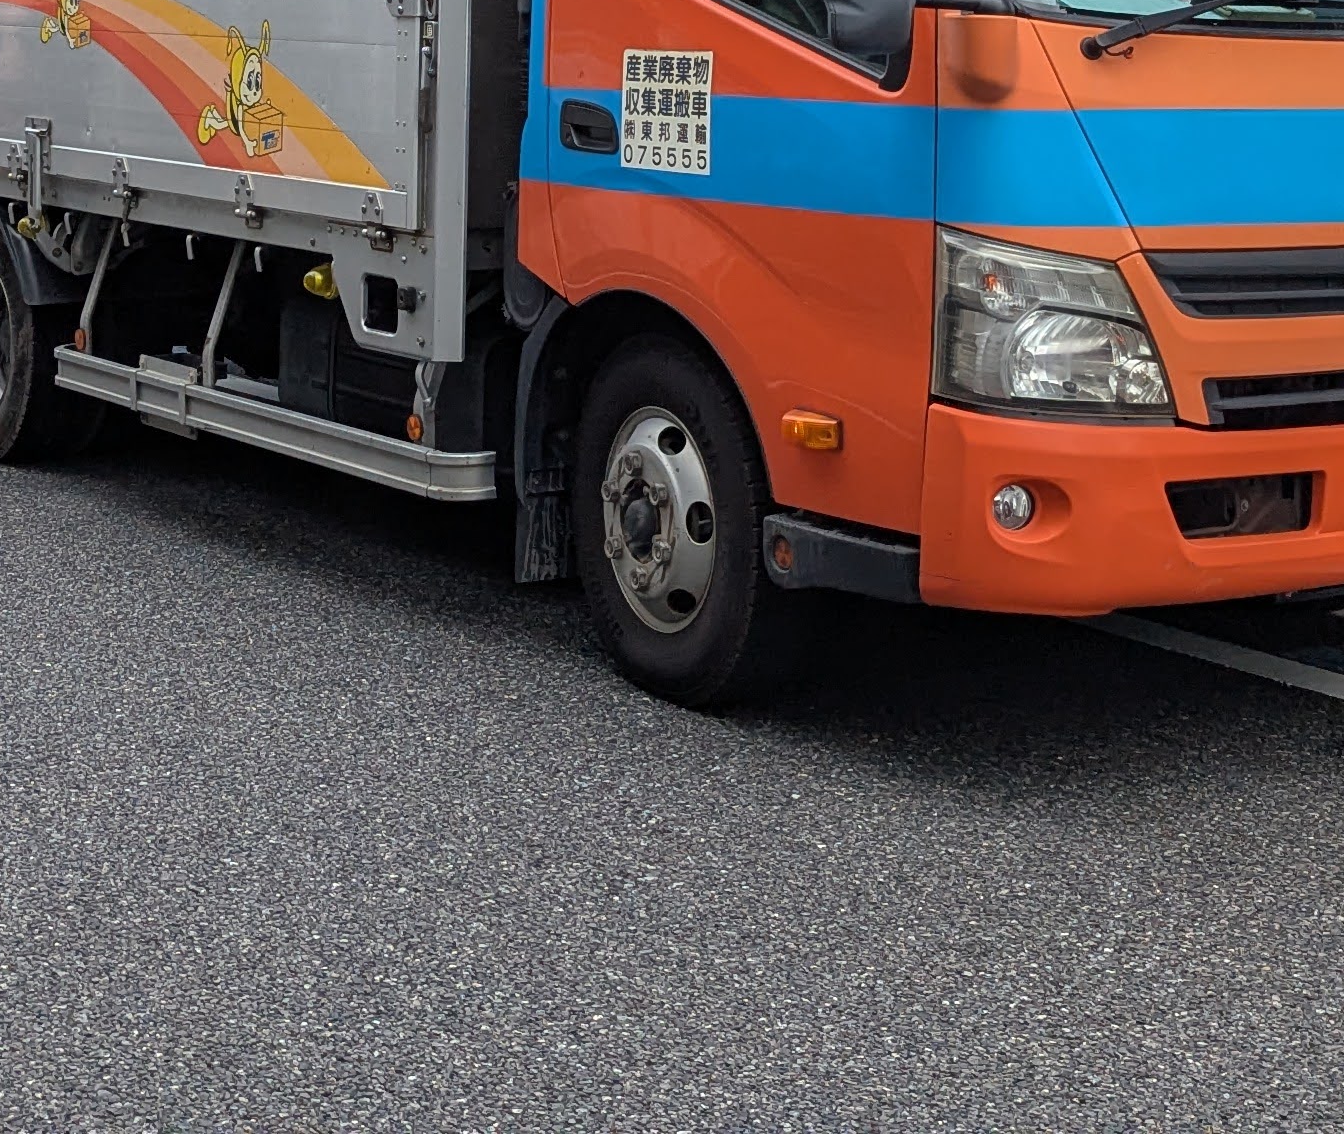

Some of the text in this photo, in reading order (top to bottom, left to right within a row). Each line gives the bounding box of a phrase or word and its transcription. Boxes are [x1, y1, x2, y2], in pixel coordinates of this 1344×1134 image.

[626, 54, 710, 85] 産業廃棄物
[625, 87, 708, 119] 収集運搬車
[623, 144, 707, 170] 075555
